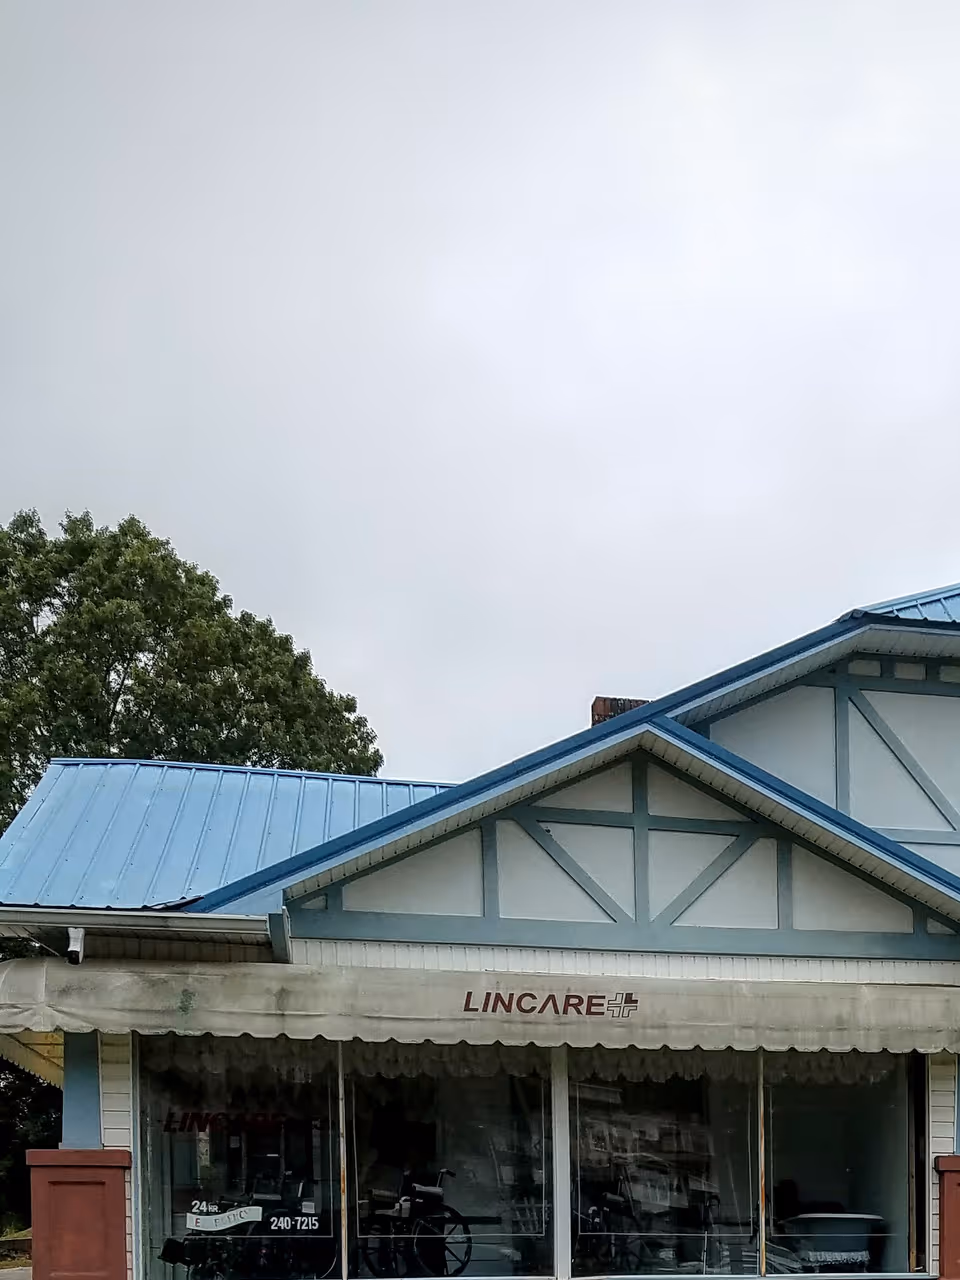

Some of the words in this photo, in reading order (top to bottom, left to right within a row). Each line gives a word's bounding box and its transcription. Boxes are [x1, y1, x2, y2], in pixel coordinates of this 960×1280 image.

[463, 991, 606, 1017] LINCARE
[192, 1200, 207, 1213] 24
[270, 1216, 319, 1230] 240-7215
